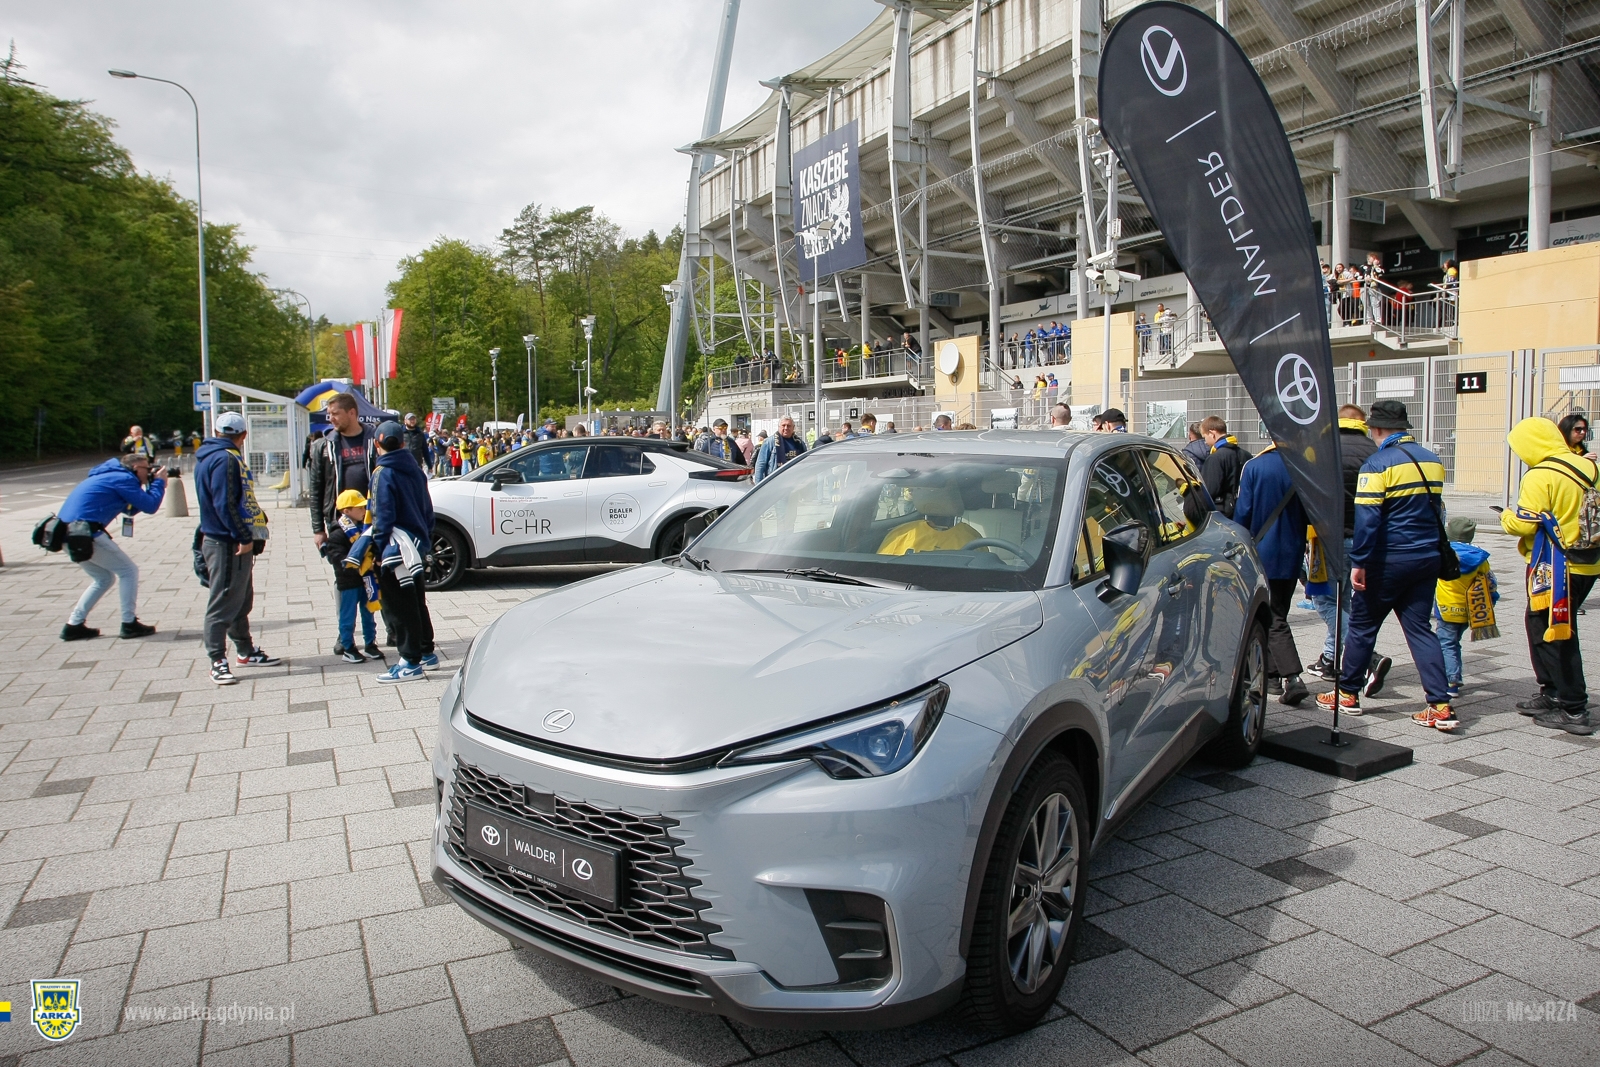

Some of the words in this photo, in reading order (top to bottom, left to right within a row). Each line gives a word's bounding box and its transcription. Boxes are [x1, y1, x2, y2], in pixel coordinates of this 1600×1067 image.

[1354, 199, 1364, 211] 22
[1508, 230, 1529, 249] 22
[1394, 252, 1402, 267] J
[1462, 376, 1480, 390] 11
[365, 415, 381, 423] Nas
[499, 509, 536, 518] TOYOTA
[500, 519, 552, 535] C-HR
[514, 838, 556, 865] WALDER
